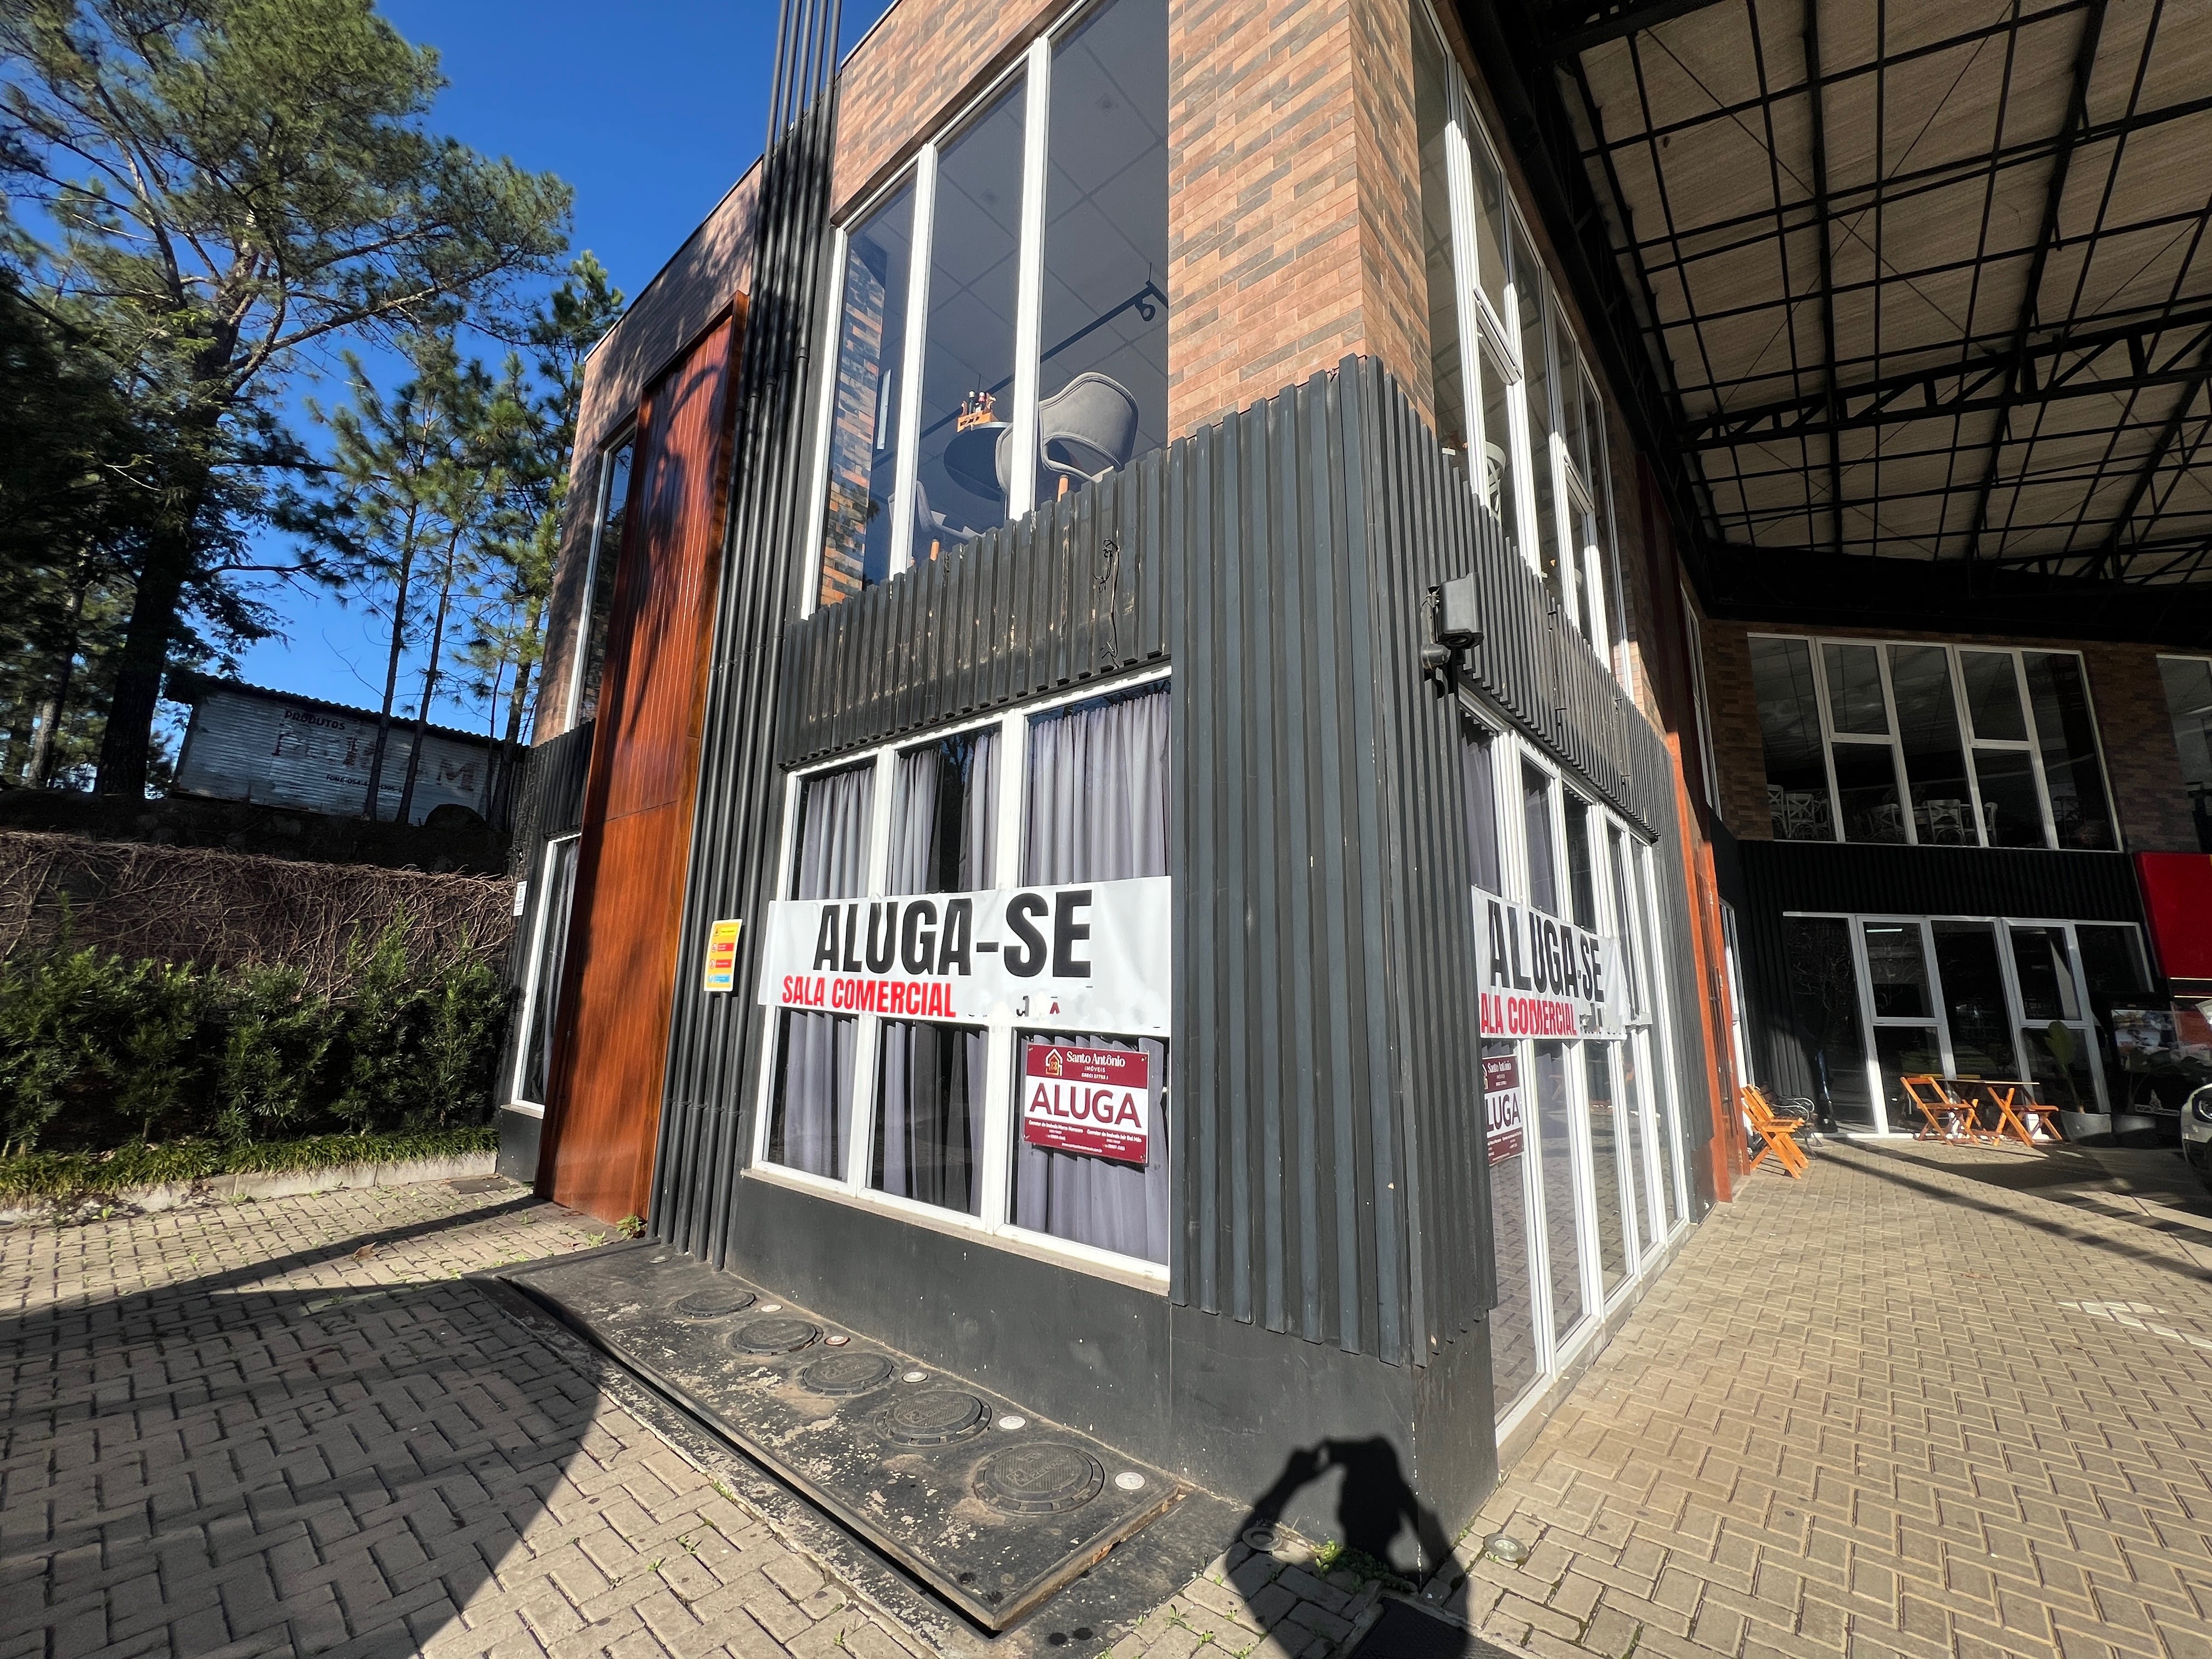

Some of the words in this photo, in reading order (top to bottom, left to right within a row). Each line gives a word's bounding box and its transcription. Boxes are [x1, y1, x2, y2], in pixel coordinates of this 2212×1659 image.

[284, 710, 346, 730] PRODUTOS
[812, 889, 1093, 978] ALUGA-SE
[1487, 899, 1605, 1002] ALUGA-SE
[782, 975, 825, 1006] SALA
[832, 978, 956, 1018] COMERCIAL
[1481, 993, 1504, 1034] ALA
[1508, 996, 1577, 1036] COMERCIAL
[1066, 1051, 1091, 1064] Santo
[1092, 1053, 1126, 1067] Antônio
[1029, 1082, 1142, 1128] ALUGA
[1485, 1092, 1521, 1131] LUGA
